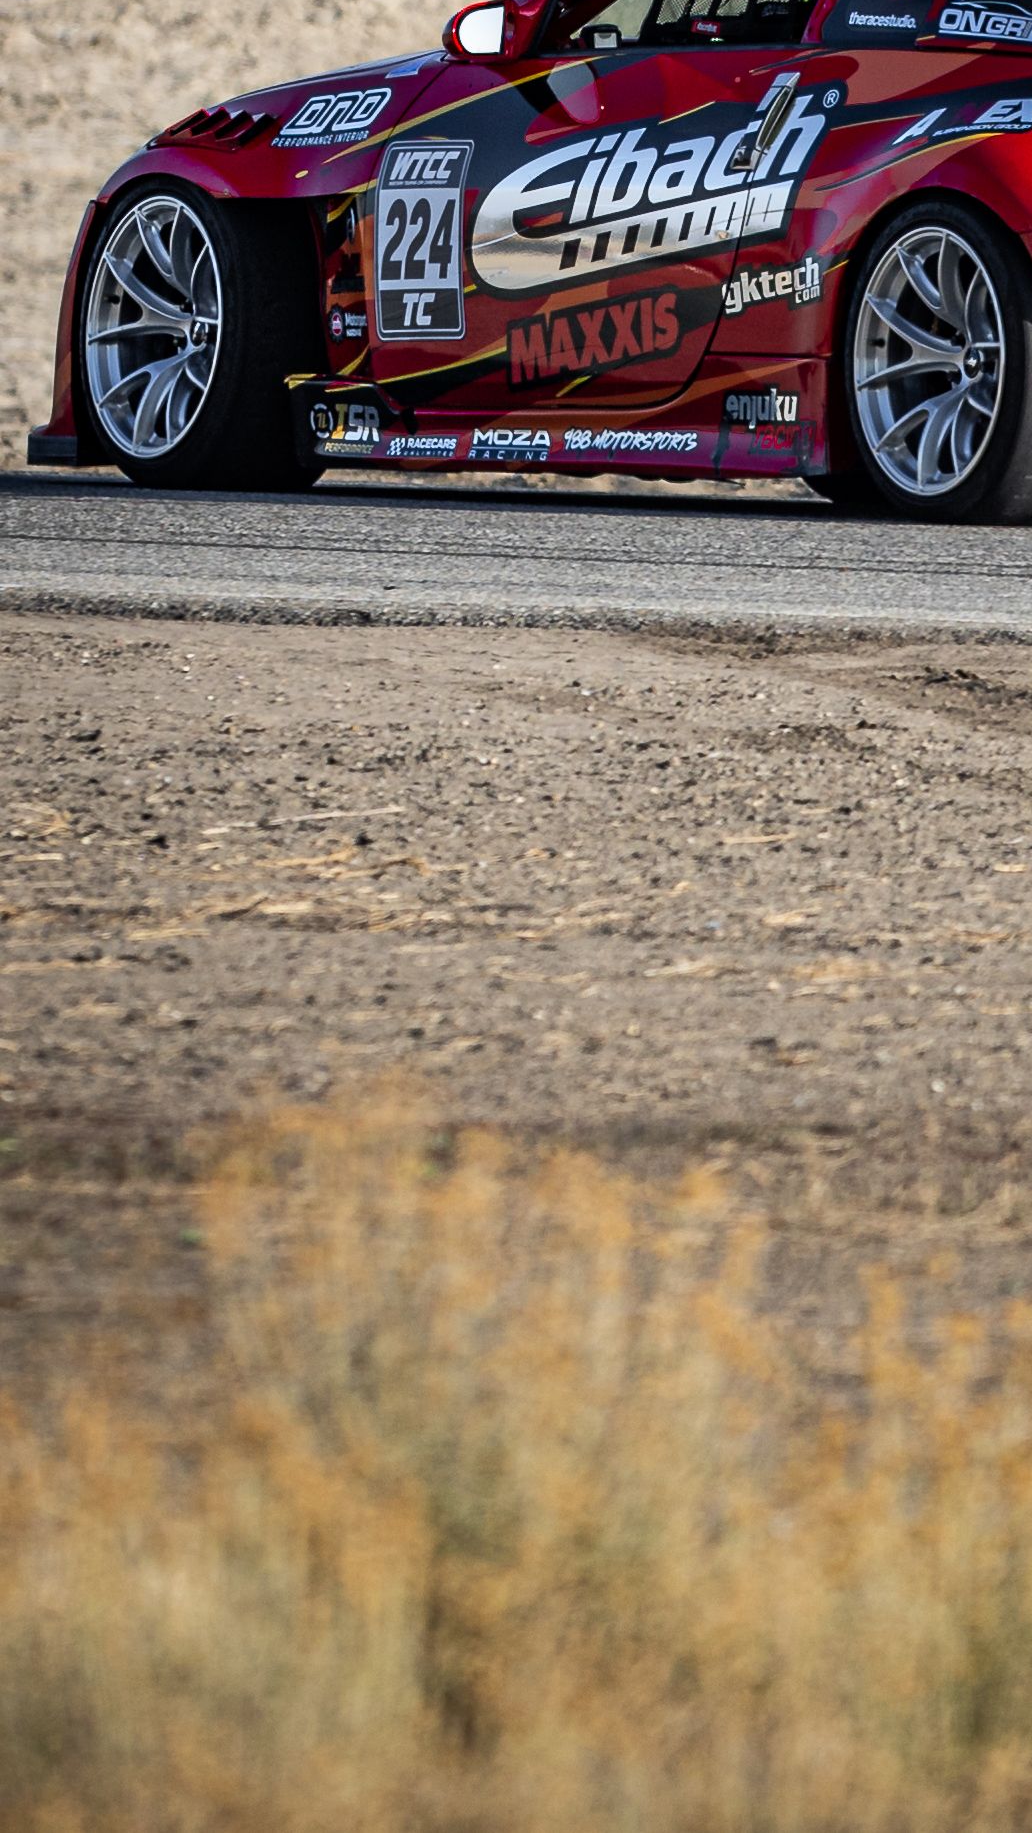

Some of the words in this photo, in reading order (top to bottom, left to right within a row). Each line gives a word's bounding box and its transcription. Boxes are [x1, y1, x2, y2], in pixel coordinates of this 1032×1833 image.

[271, 133, 332, 147] PERFORMANCE
[334, 130, 370, 144] INTERIOR
[389, 150, 461, 181] WTCC
[381, 197, 456, 281] 224
[722, 257, 819, 314] gktech
[403, 292, 436, 327] TC
[509, 292, 680, 383] MAXXIS
[331, 403, 380, 442] ISR
[726, 388, 798, 428] enjuku
[407, 437, 457, 450] RACECARS
[472, 429, 550, 447] MOZA
[564, 427, 592, 451] 988
[593, 428, 697, 451] MOTORSPORTS
[467, 449, 548, 462] RACING
